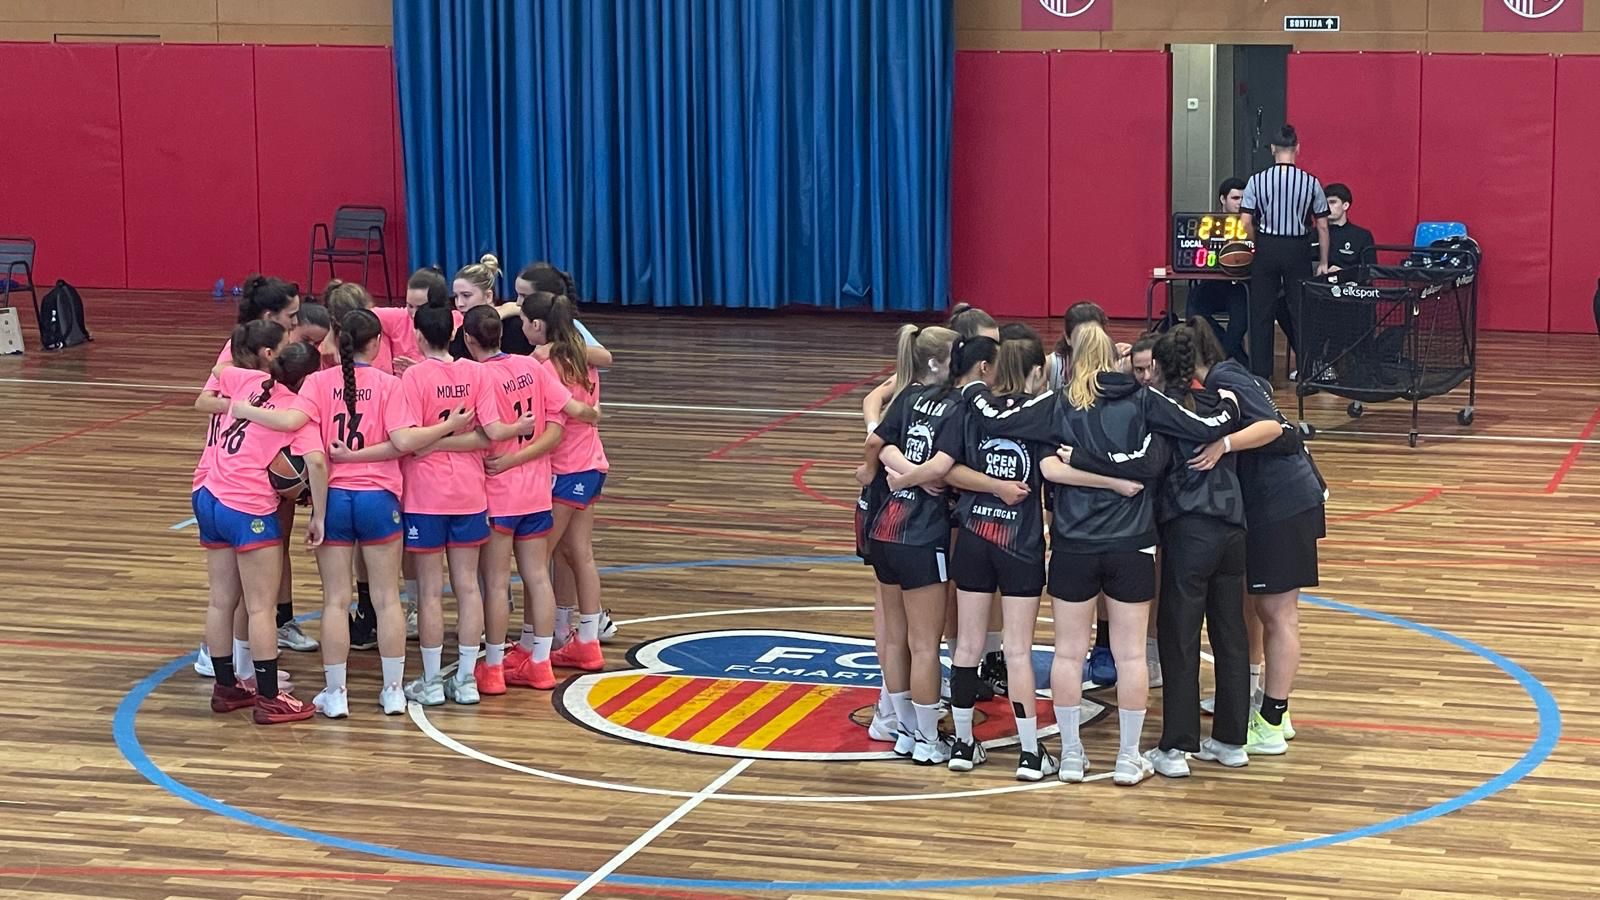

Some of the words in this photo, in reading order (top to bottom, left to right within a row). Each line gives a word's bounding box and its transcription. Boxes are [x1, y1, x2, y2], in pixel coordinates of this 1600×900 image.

[1289, 19, 1323, 28] SORTIDA
[1180, 239, 1203, 248] LOCAL
[1342, 286, 1380, 298] elksport
[333, 388, 372, 401] MERO
[985, 452, 1018, 468] OPEN
[985, 464, 1017, 479] ARMS
[972, 505, 993, 517] SANT
[992, 508, 1018, 520] CUGAT
[723, 664, 883, 681] FCMART
